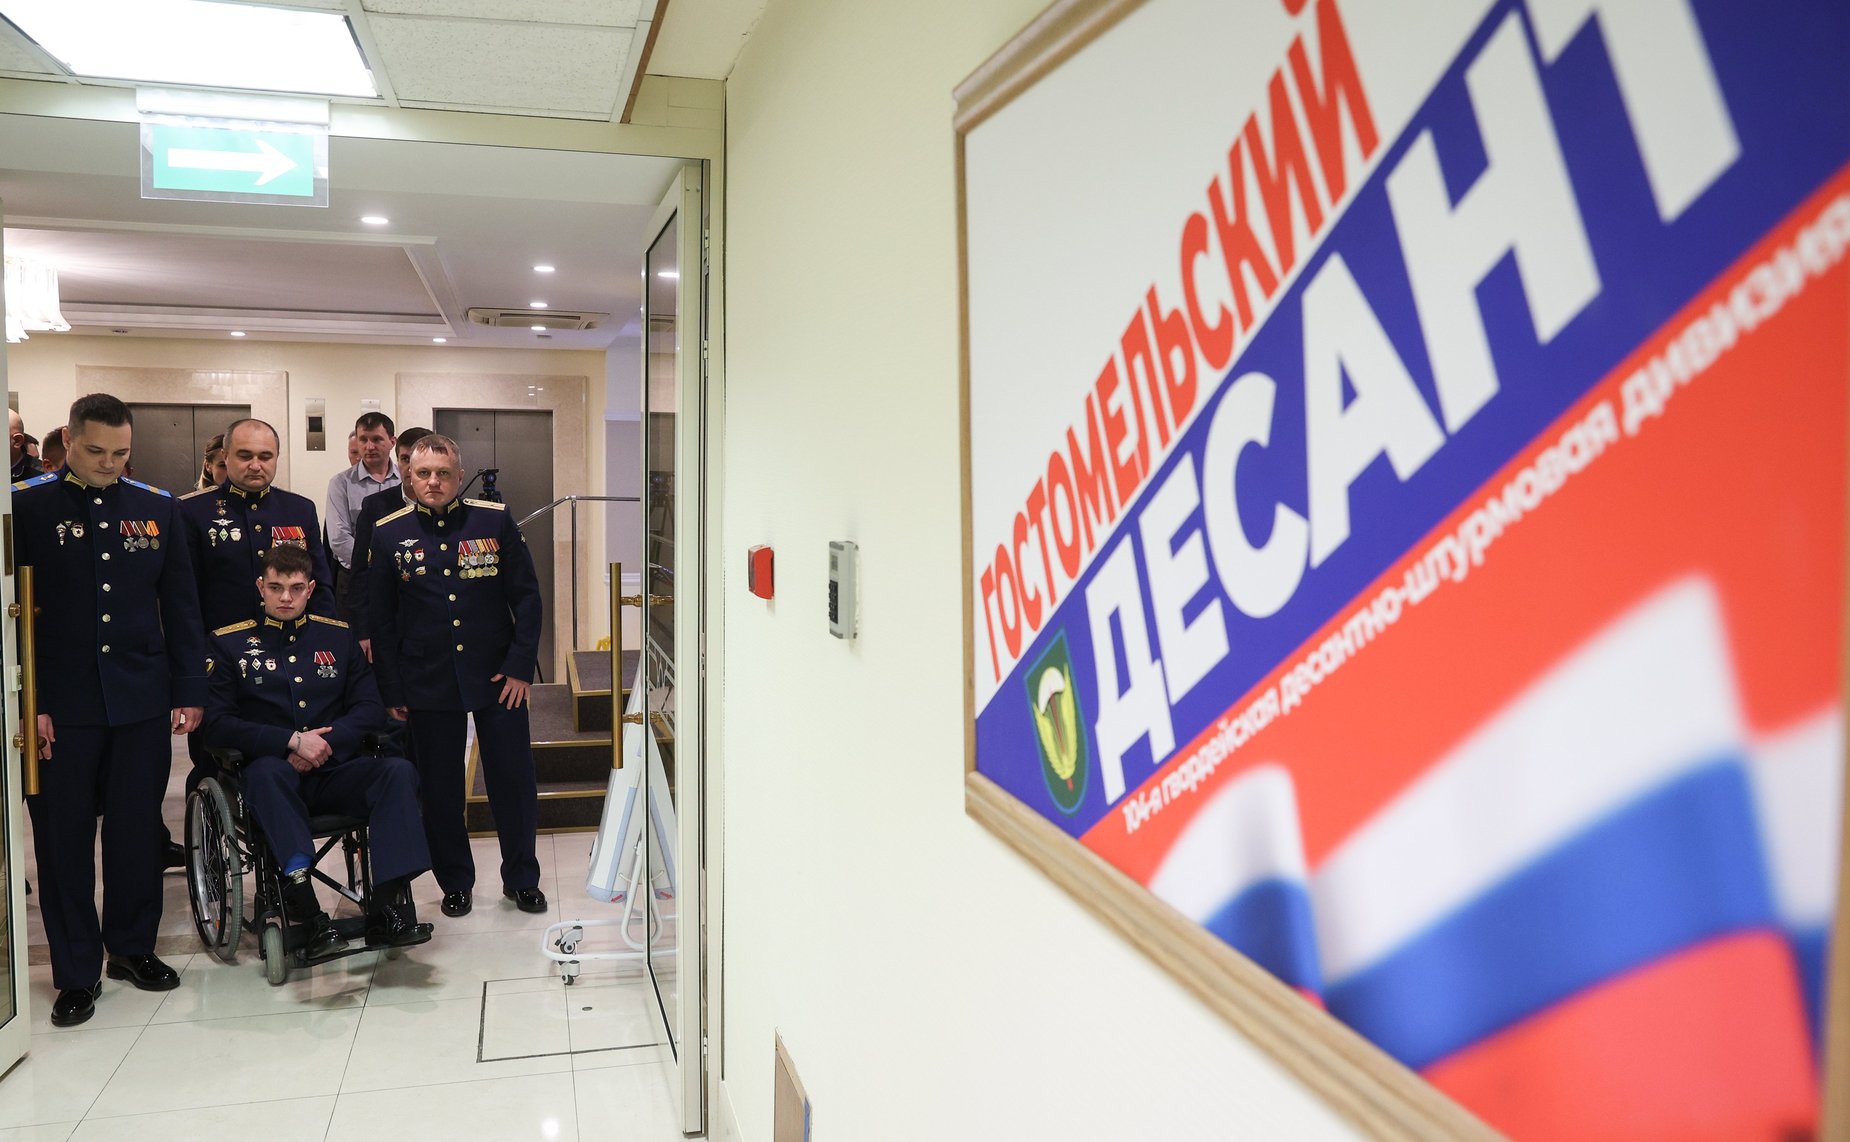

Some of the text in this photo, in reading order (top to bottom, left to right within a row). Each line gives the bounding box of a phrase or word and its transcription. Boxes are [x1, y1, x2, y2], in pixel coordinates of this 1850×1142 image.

[981, 0, 1379, 684] ГОСТОМЕЛЬСКИЙ
[1161, 687, 1280, 805] гвардейская
[1279, 400, 1619, 714] десантно-штурмовая
